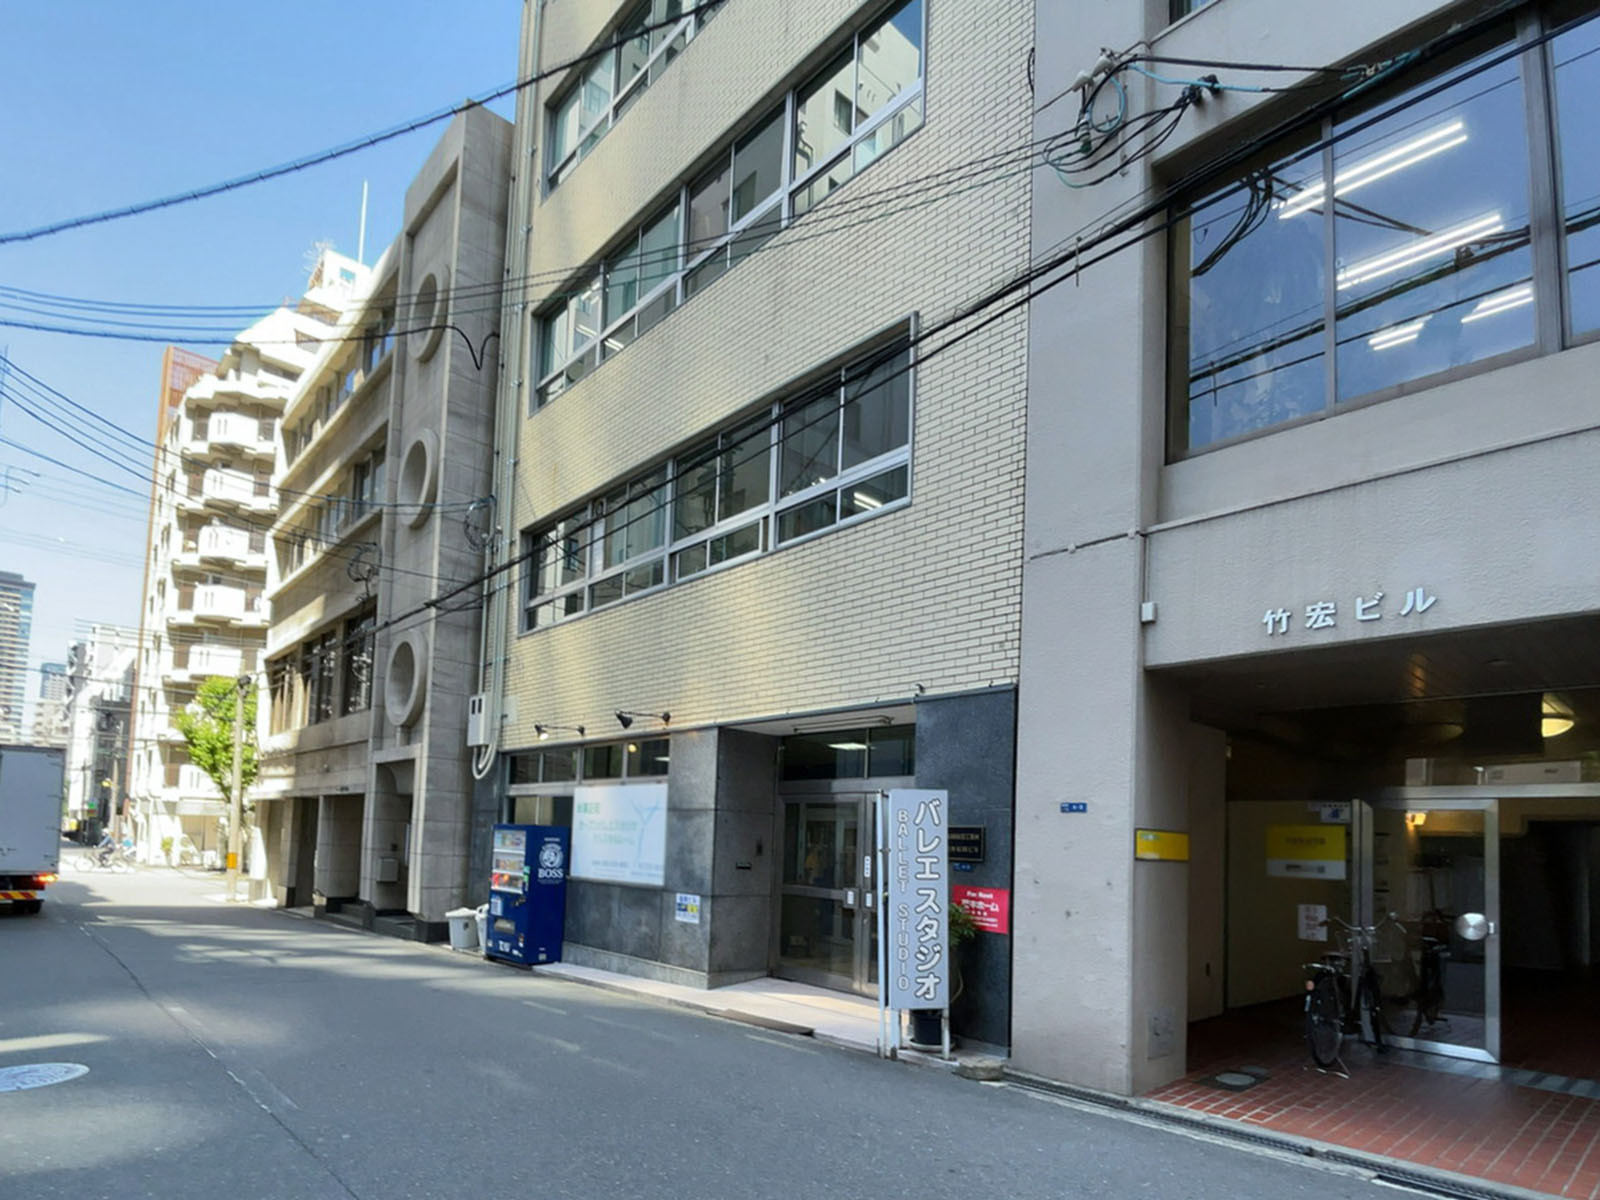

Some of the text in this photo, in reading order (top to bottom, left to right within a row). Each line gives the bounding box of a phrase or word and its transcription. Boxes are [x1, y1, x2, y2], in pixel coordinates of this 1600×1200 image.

[1262, 586, 1438, 636] 竹宏ビル
[537, 867, 564, 878] BOSS
[896, 809, 909, 990] BALLET STUDIO
[914, 797, 942, 1000] バレエスタジオ
